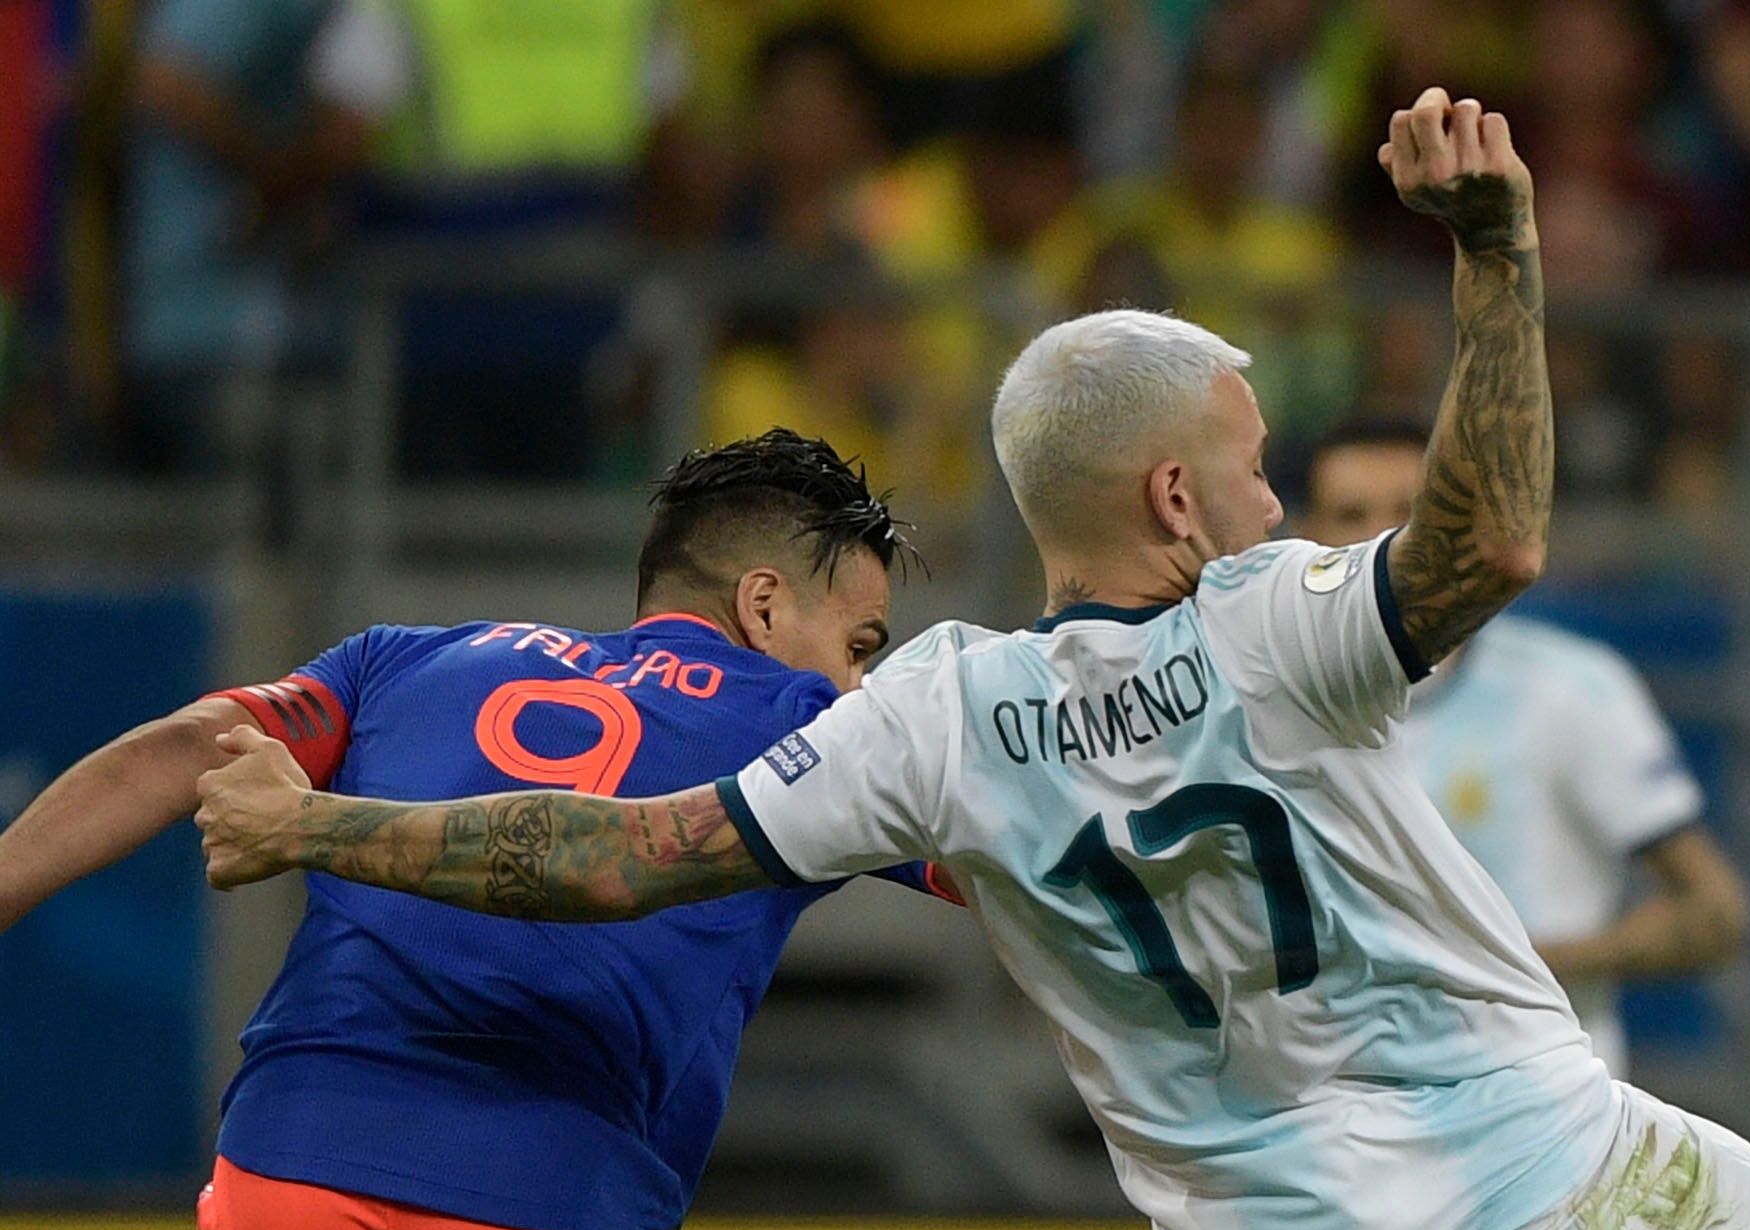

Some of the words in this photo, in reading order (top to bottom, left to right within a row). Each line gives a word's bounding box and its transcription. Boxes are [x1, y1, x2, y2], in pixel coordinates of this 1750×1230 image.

[469, 622, 724, 699] FALCAO
[474, 678, 643, 798] 9
[1042, 782, 1320, 1029] 17
